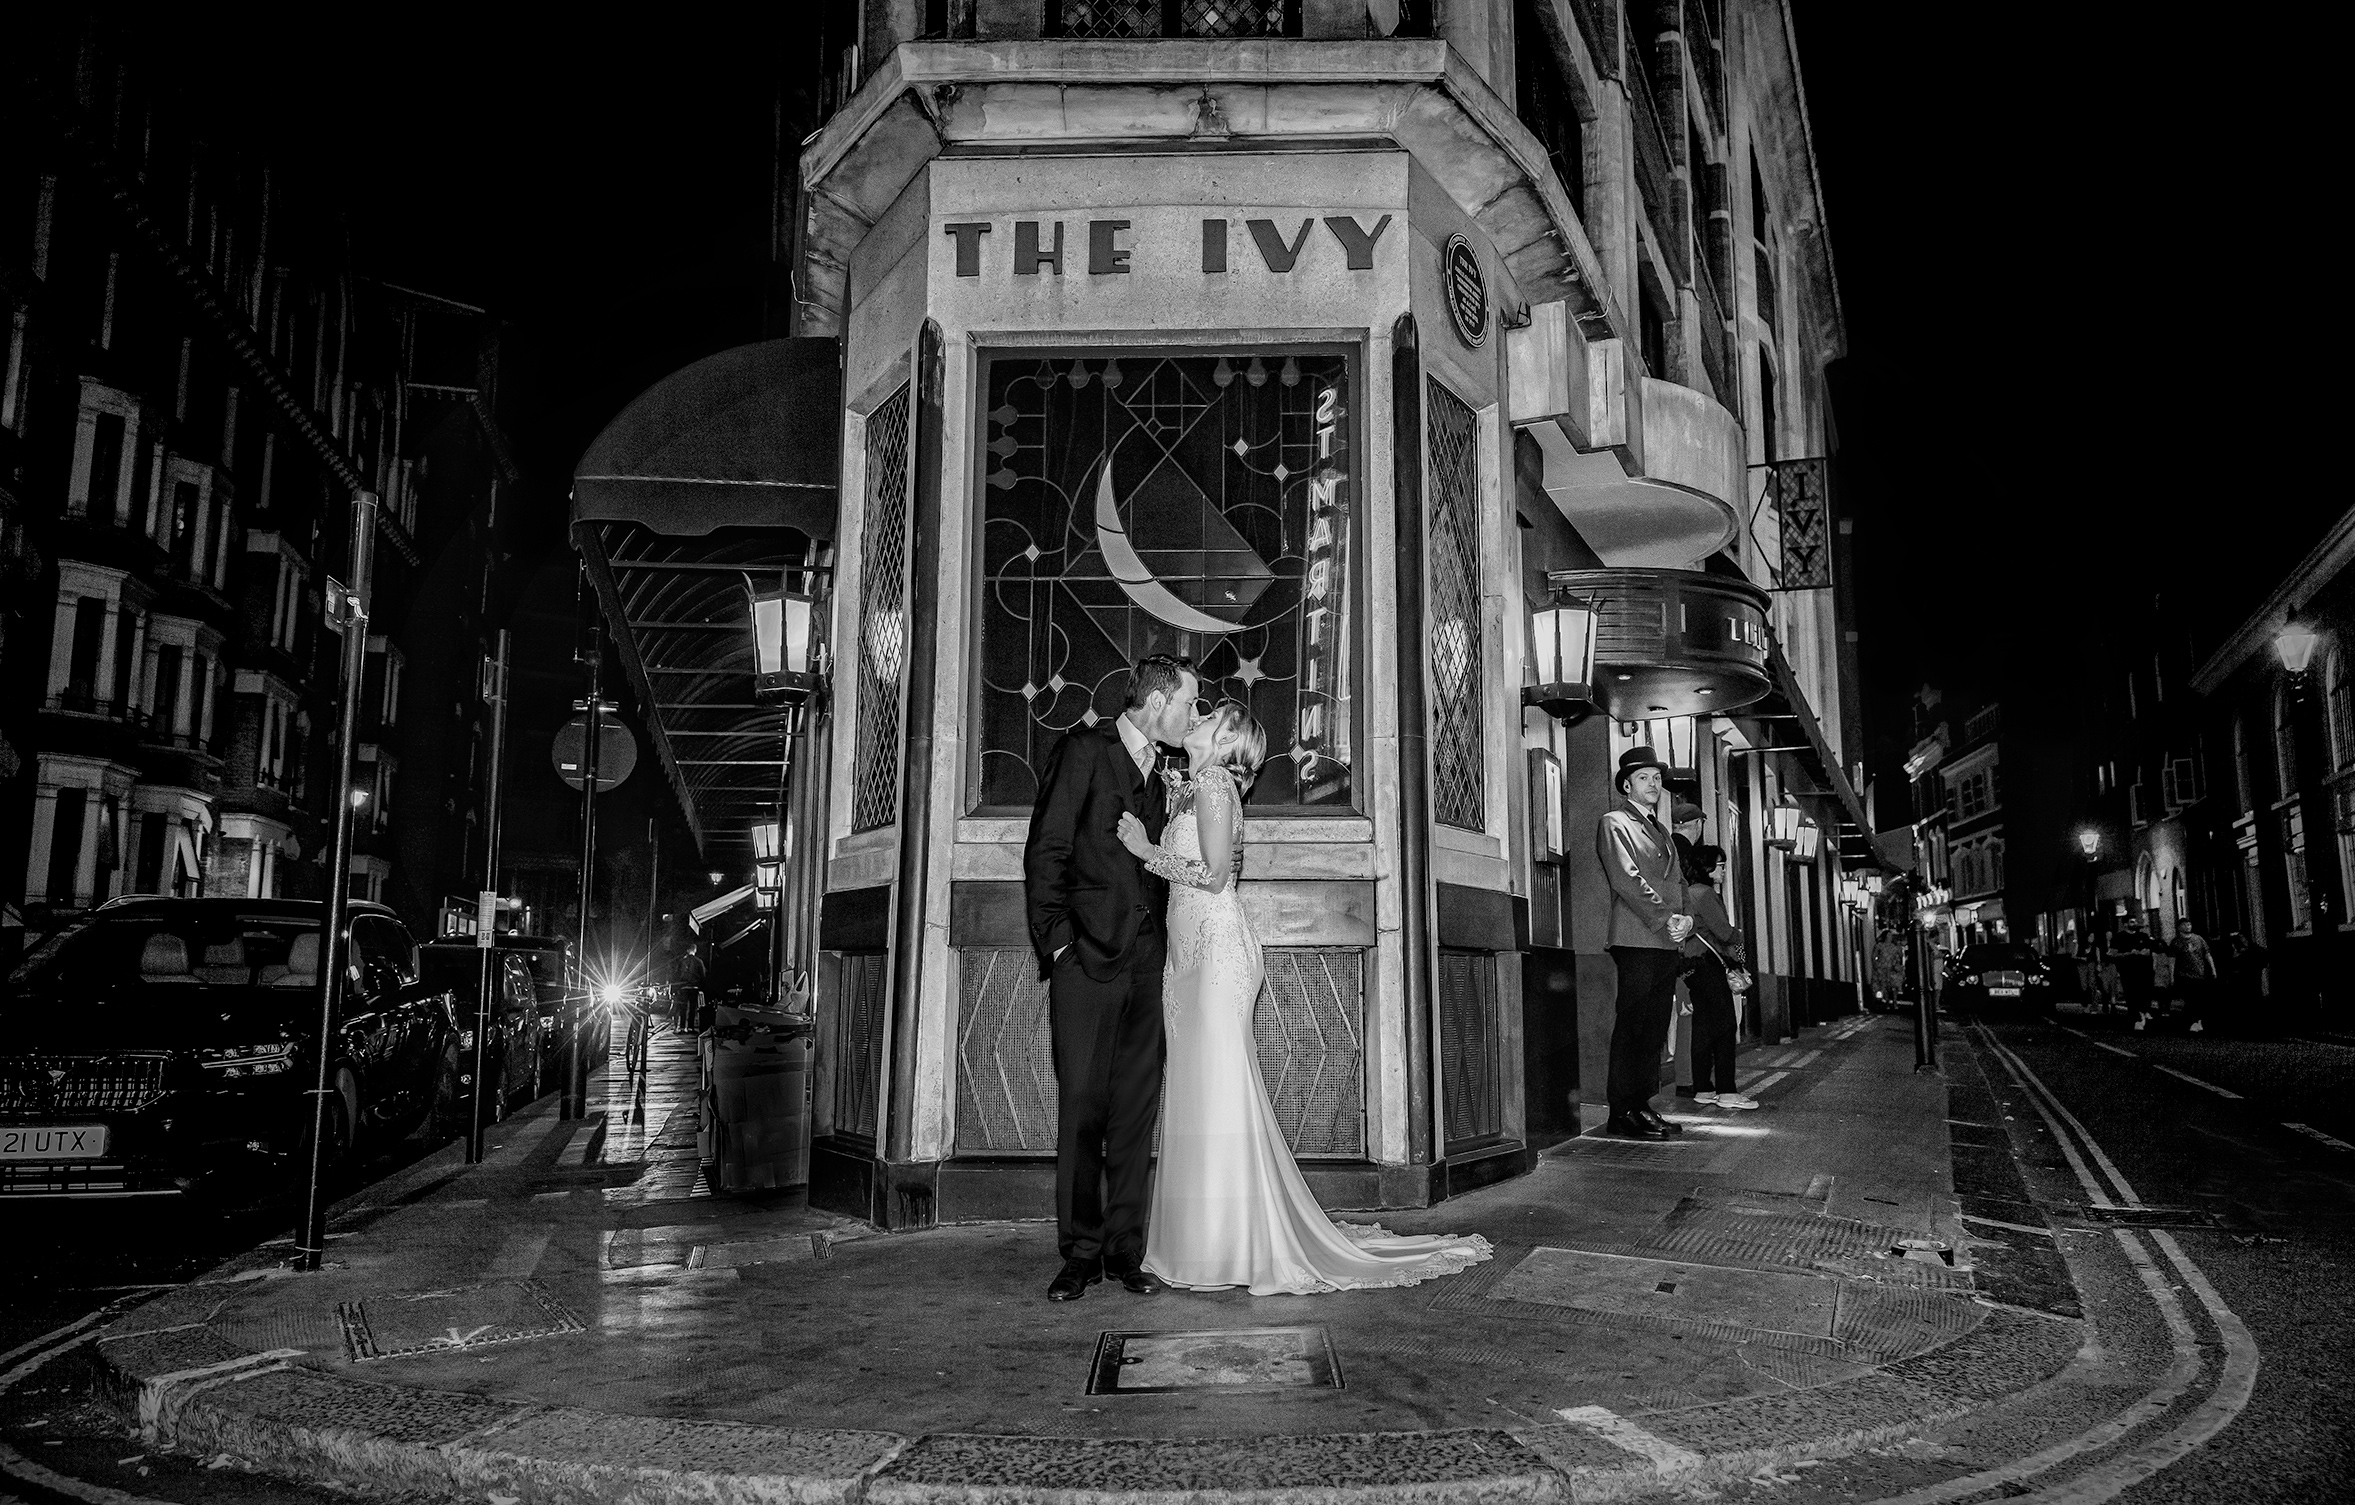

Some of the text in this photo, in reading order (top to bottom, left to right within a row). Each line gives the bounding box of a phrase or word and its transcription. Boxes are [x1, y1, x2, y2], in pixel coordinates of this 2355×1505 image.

[944, 214, 1392, 277] THE IVY
[1786, 472, 1821, 575] IVY
[35, 1131, 86, 1152] UTX
